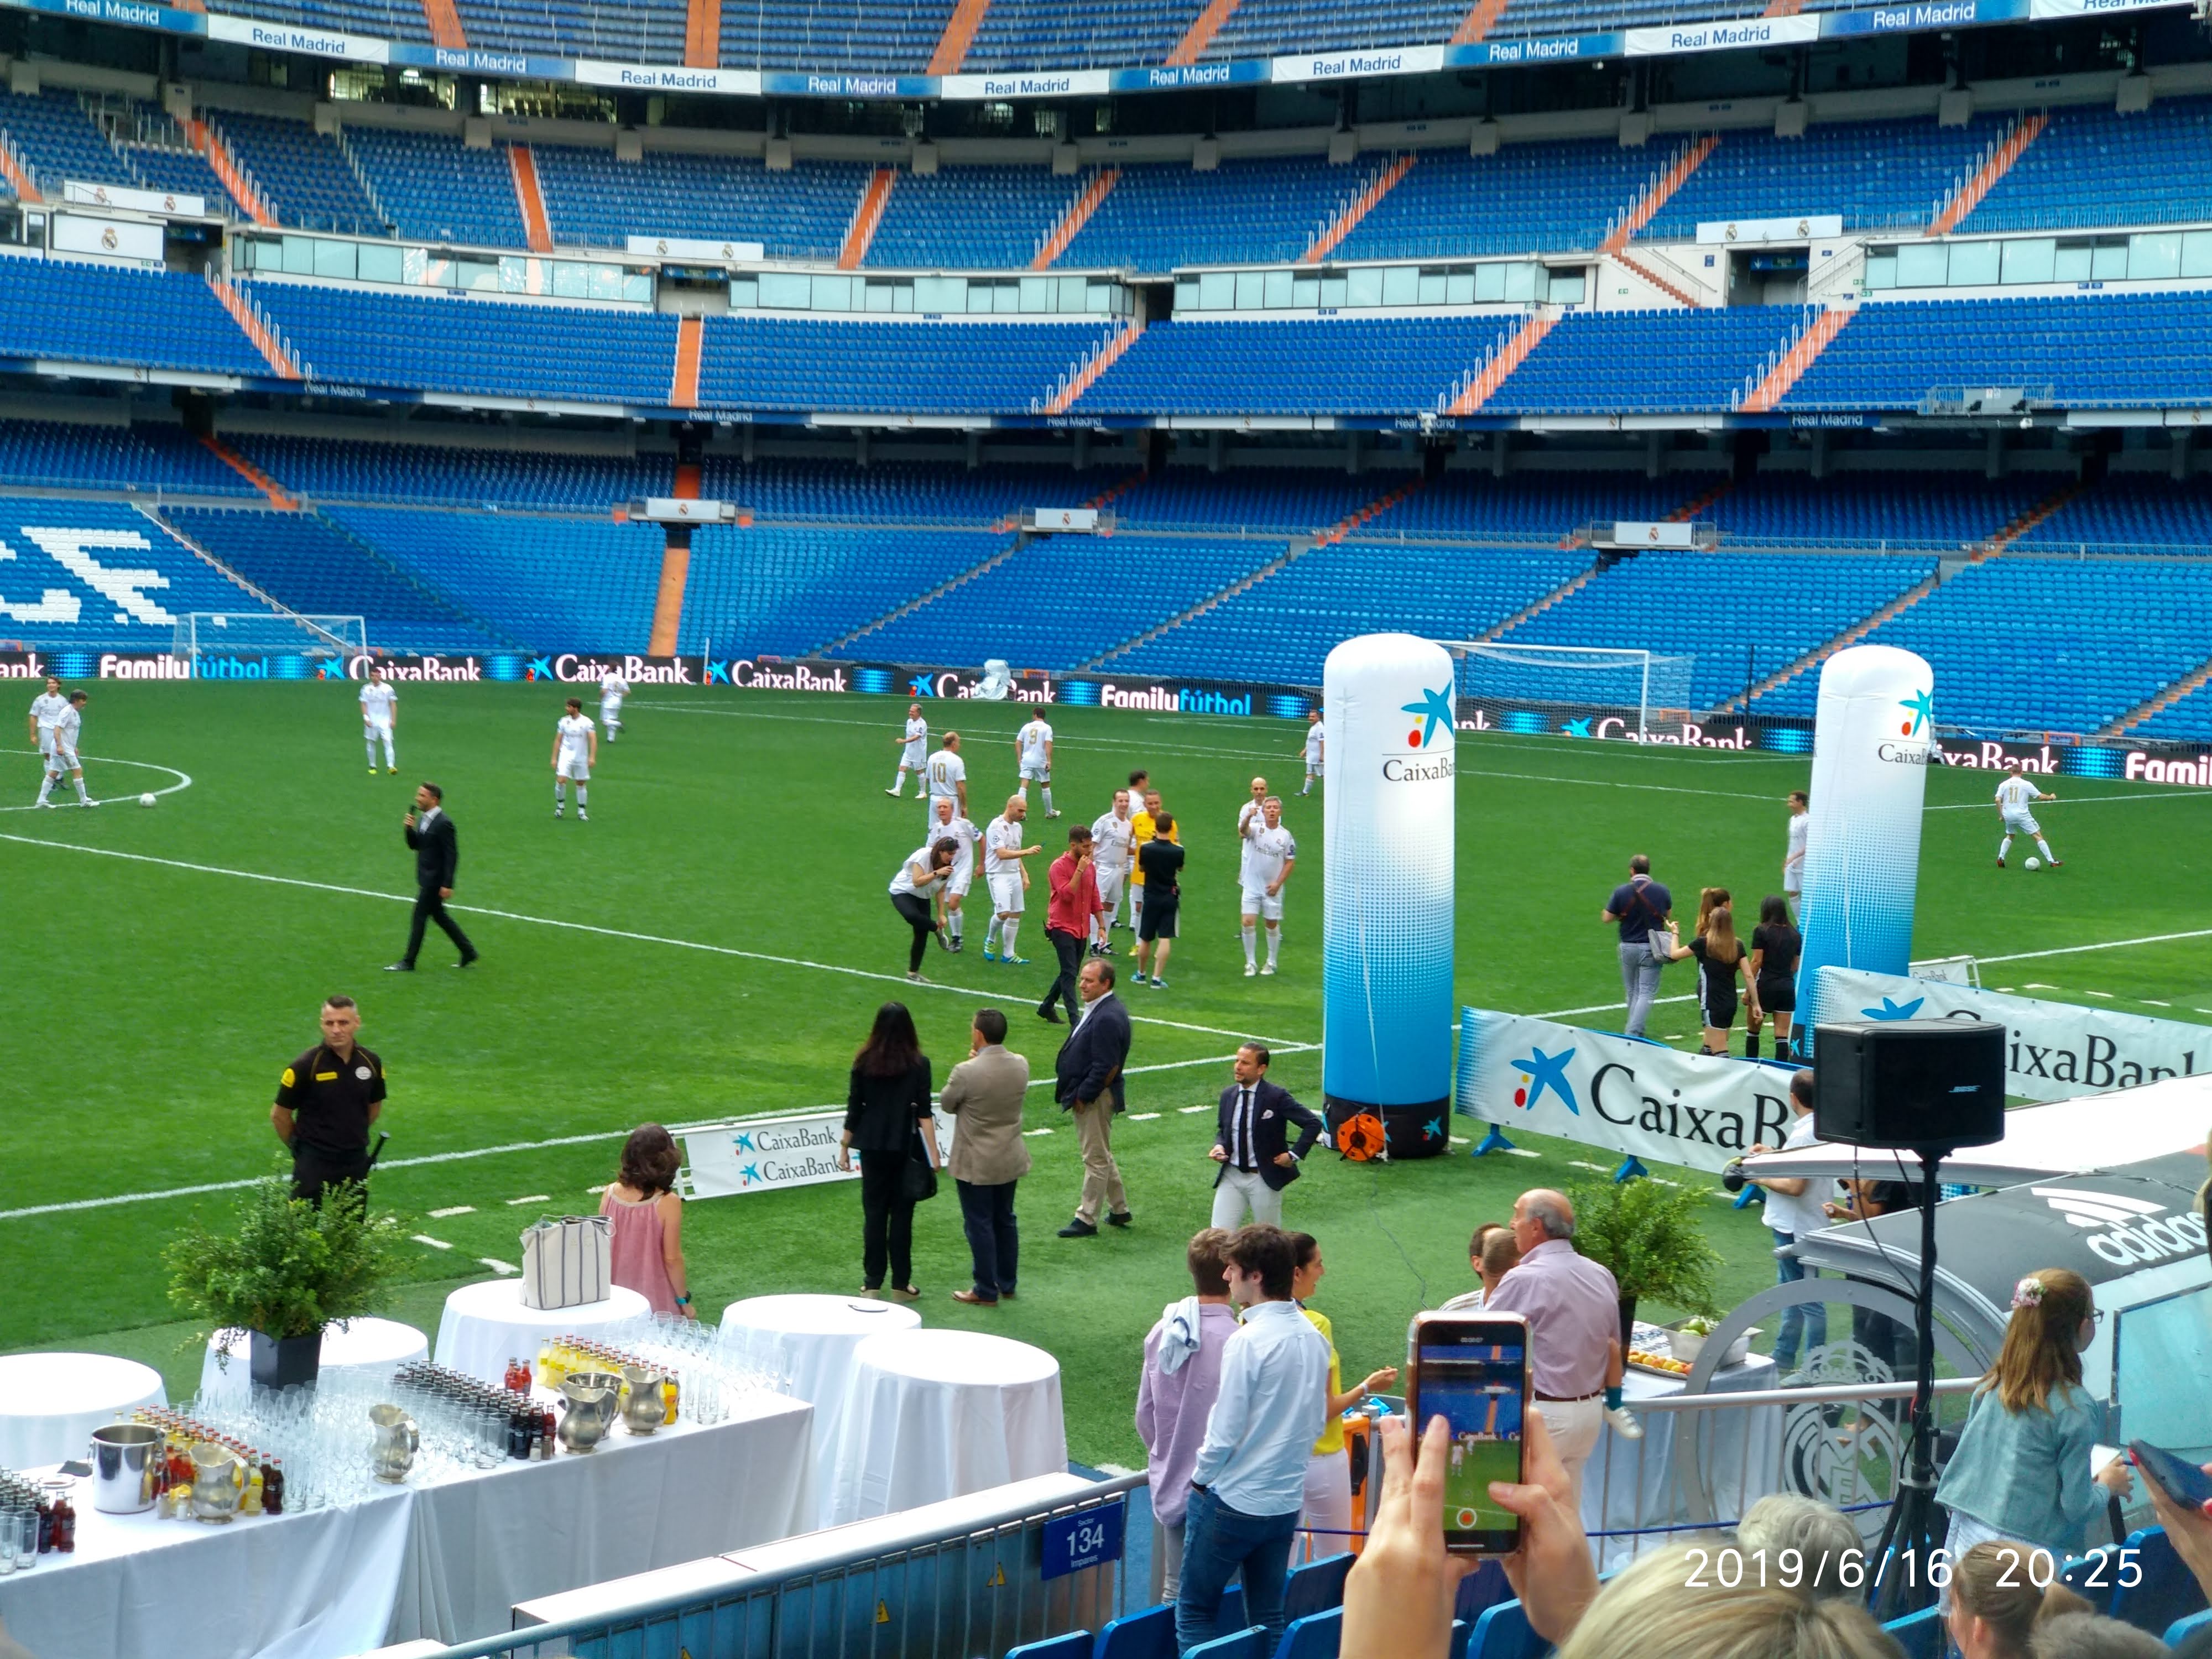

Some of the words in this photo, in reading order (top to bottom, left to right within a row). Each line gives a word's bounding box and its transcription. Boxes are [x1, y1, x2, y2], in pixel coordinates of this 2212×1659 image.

[66, 0, 100, 11] Real
[106, 1, 159, 25] Madrid
[1874, 9, 1910, 29] Real
[1916, 3, 1975, 25] Madrid
[253, 28, 286, 46] Real
[291, 34, 346, 55] Madrid
[1672, 32, 1707, 48] Real
[1713, 25, 1770, 44] Madrid
[1490, 43, 1522, 61] Real
[1526, 39, 1578, 59] Madrid
[436, 49, 468, 67] Real
[474, 53, 526, 74] Madrid
[1313, 59, 1345, 75] Real
[1350, 56, 1401, 72] Madrid
[622, 70, 656, 86] Real
[662, 72, 717, 89] Madrid
[808, 76, 841, 93] Real
[846, 77, 896, 94] Madrid
[985, 81, 1016, 95] Real
[1021, 78, 1070, 93] Madrid
[1150, 70, 1178, 86] Real
[1183, 65, 1229, 84] Madrid
[1792, 414, 1818, 426] Real
[1820, 414, 1863, 426] Madrid
[731, 660, 847, 692] CaixaBank
[1029, 728, 1038, 744] 9
[932, 763, 946, 783] 10
[2009, 786, 2018, 804] 11
[1590, 1063, 1790, 1150] CaixaB
[757, 1126, 837, 1151] CaixaBank
[763, 1155, 843, 1181] CaixaBank
[1066, 1524, 1105, 1557] 134
